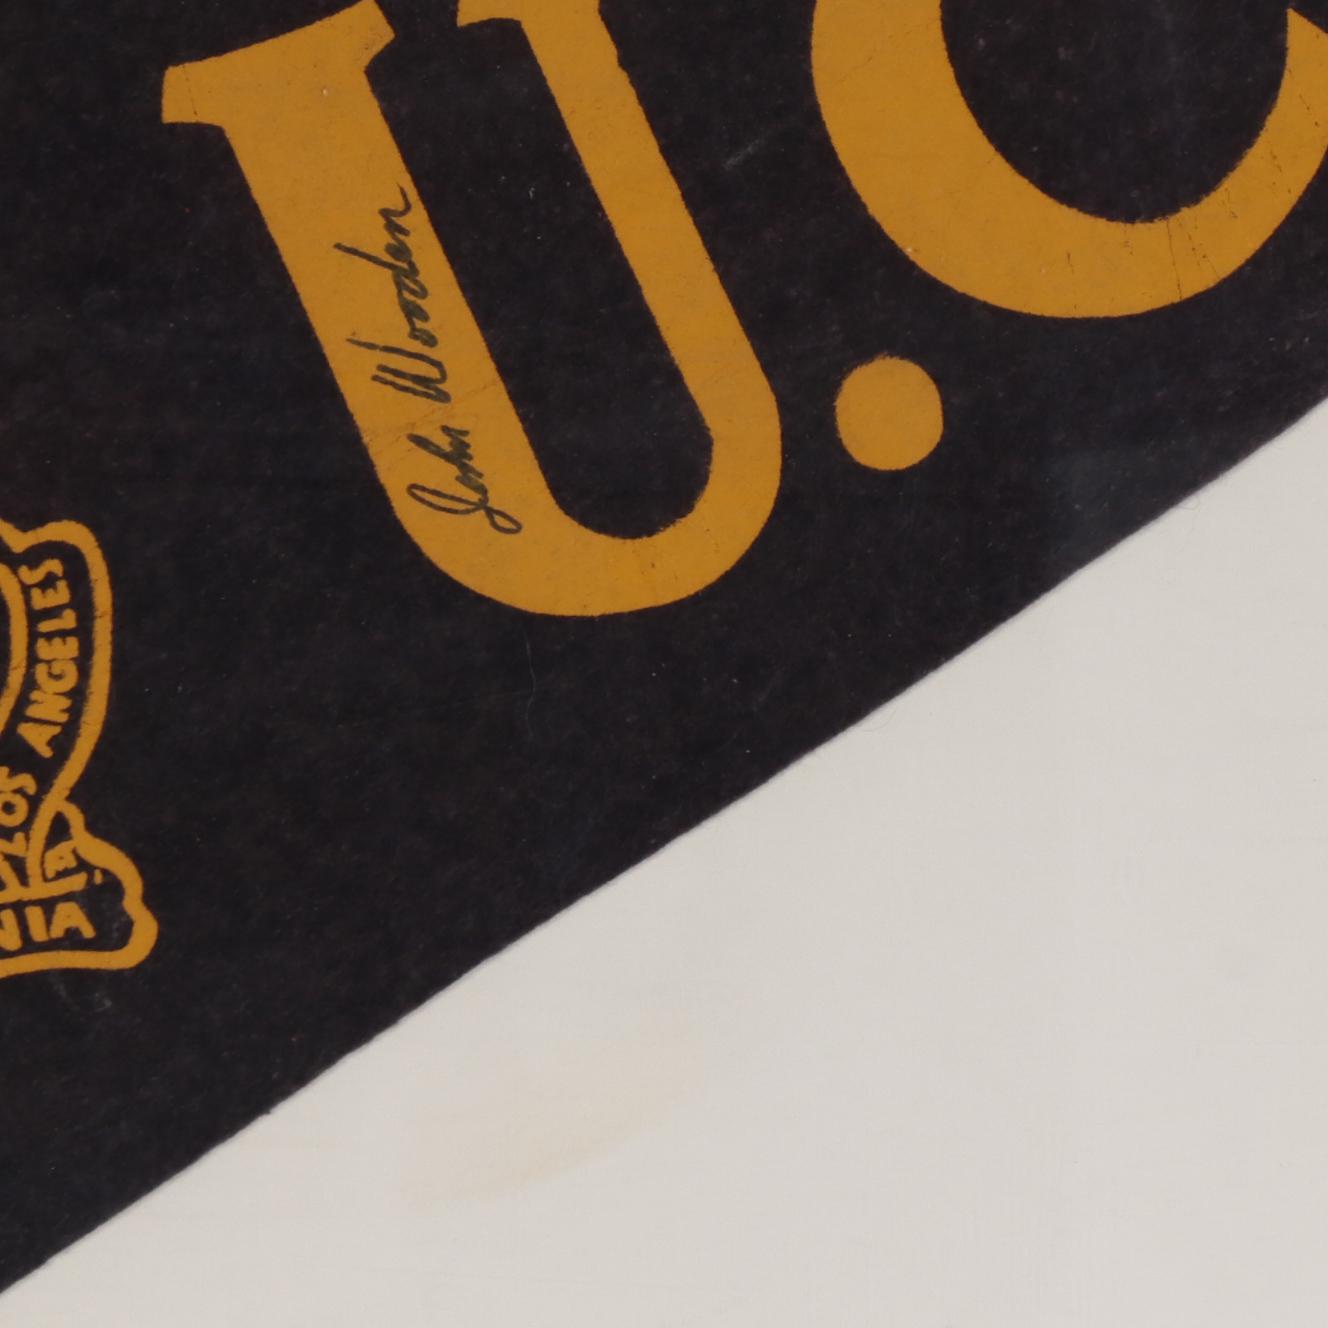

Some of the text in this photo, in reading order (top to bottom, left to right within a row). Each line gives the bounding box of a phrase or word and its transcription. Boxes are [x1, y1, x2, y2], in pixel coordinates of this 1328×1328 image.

[333, 182, 523, 535] John Wooden
[17, 558, 80, 758] ANGELES
